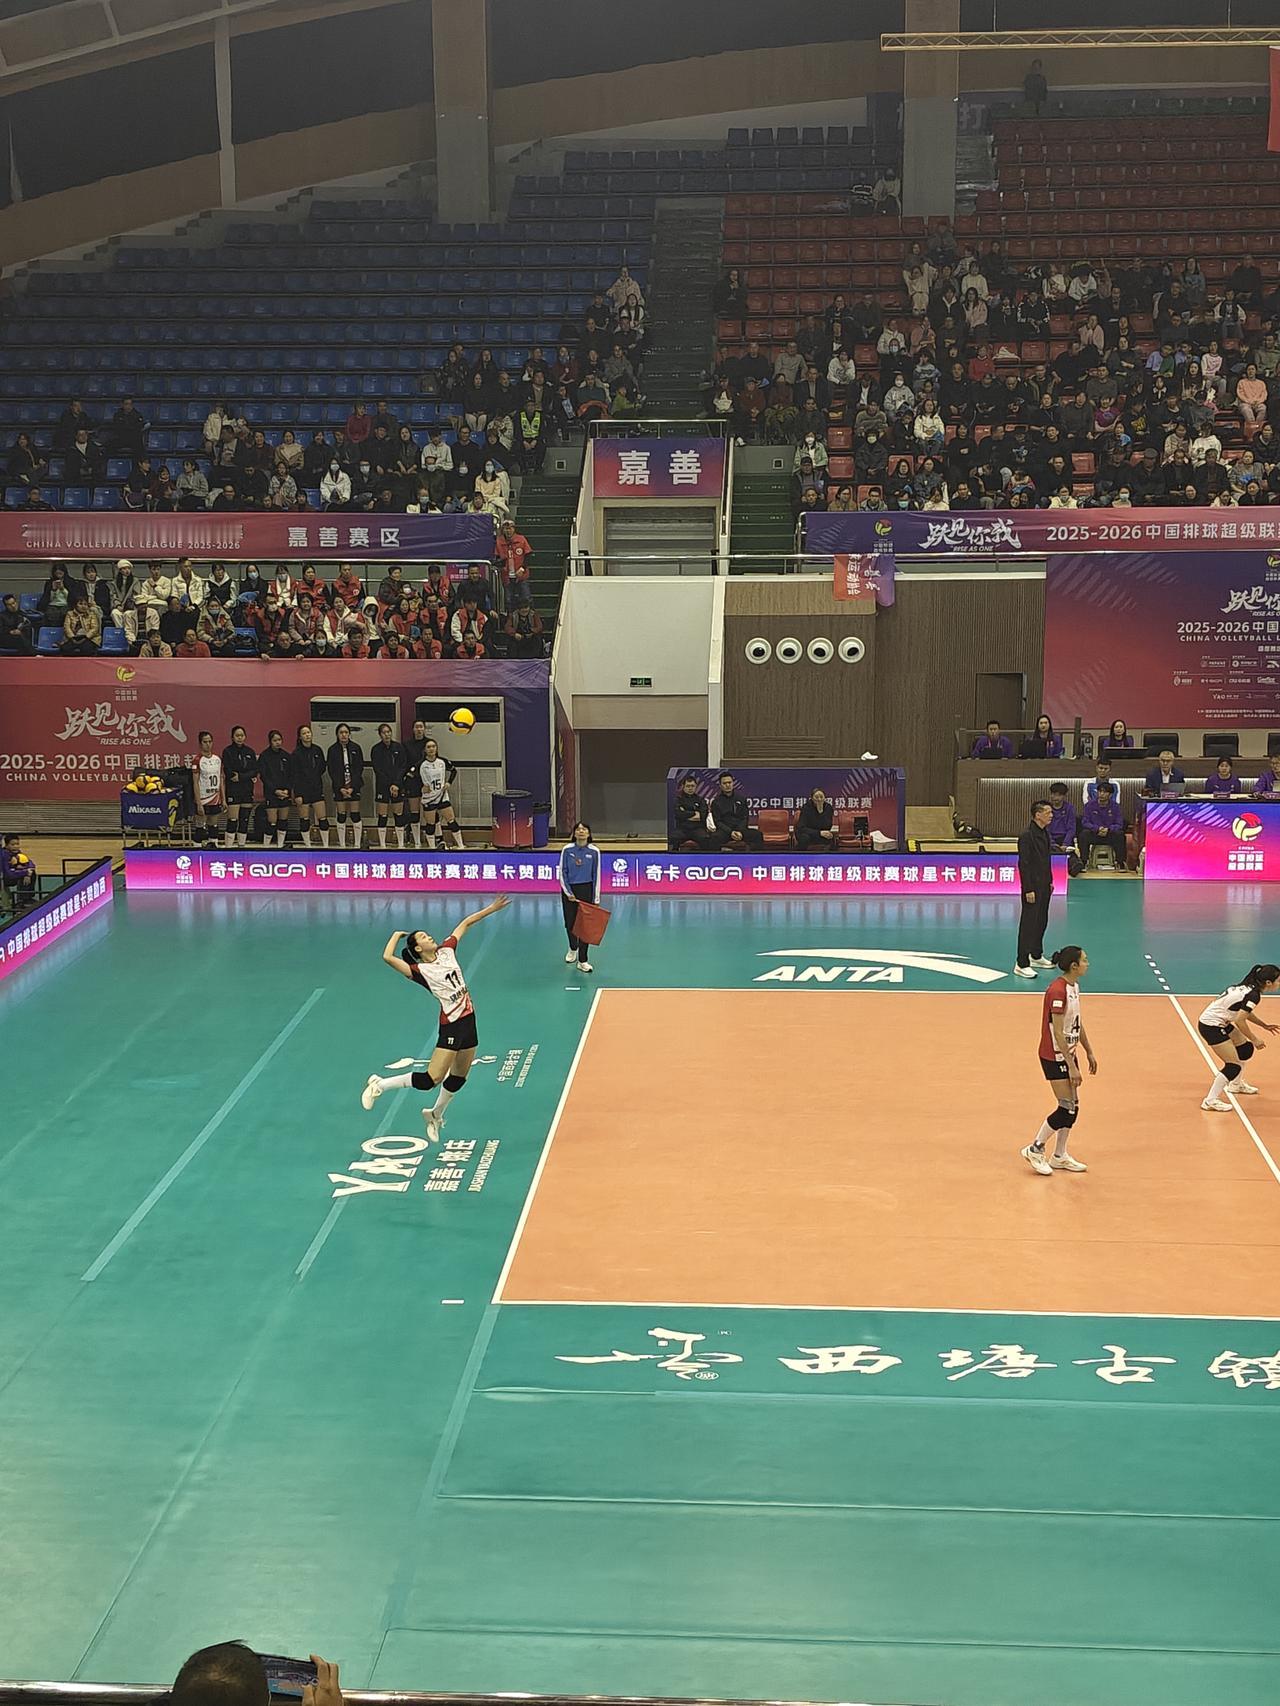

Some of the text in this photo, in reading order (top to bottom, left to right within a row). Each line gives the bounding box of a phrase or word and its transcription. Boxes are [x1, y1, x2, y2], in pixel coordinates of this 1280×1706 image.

[618, 450, 702, 485] 嘉善
[288, 527, 400, 548] 嘉善赛区
[918, 518, 1022, 549] 跃见你我
[1146, 523, 1280, 539] 中国排球超级联
[26, 540, 241, 549] CHINA VOLLEYBALL LEAGUE 2025-2026
[1177, 621, 1250, 633] 2025-2026
[54, 701, 188, 742] 跃见你我
[0, 754, 100, 770] 2025-2026
[6, 773, 133, 782] CHINA VOLLEYBALL
[431, 779, 442, 791] 15
[210, 861, 244, 878] 奇卡
[645, 864, 680, 882] 奇卡
[752, 866, 1015, 882] 中国排球超级联赛球星卡赞助商
[445, 970, 461, 989] 11
[752, 965, 904, 983] ANTA
